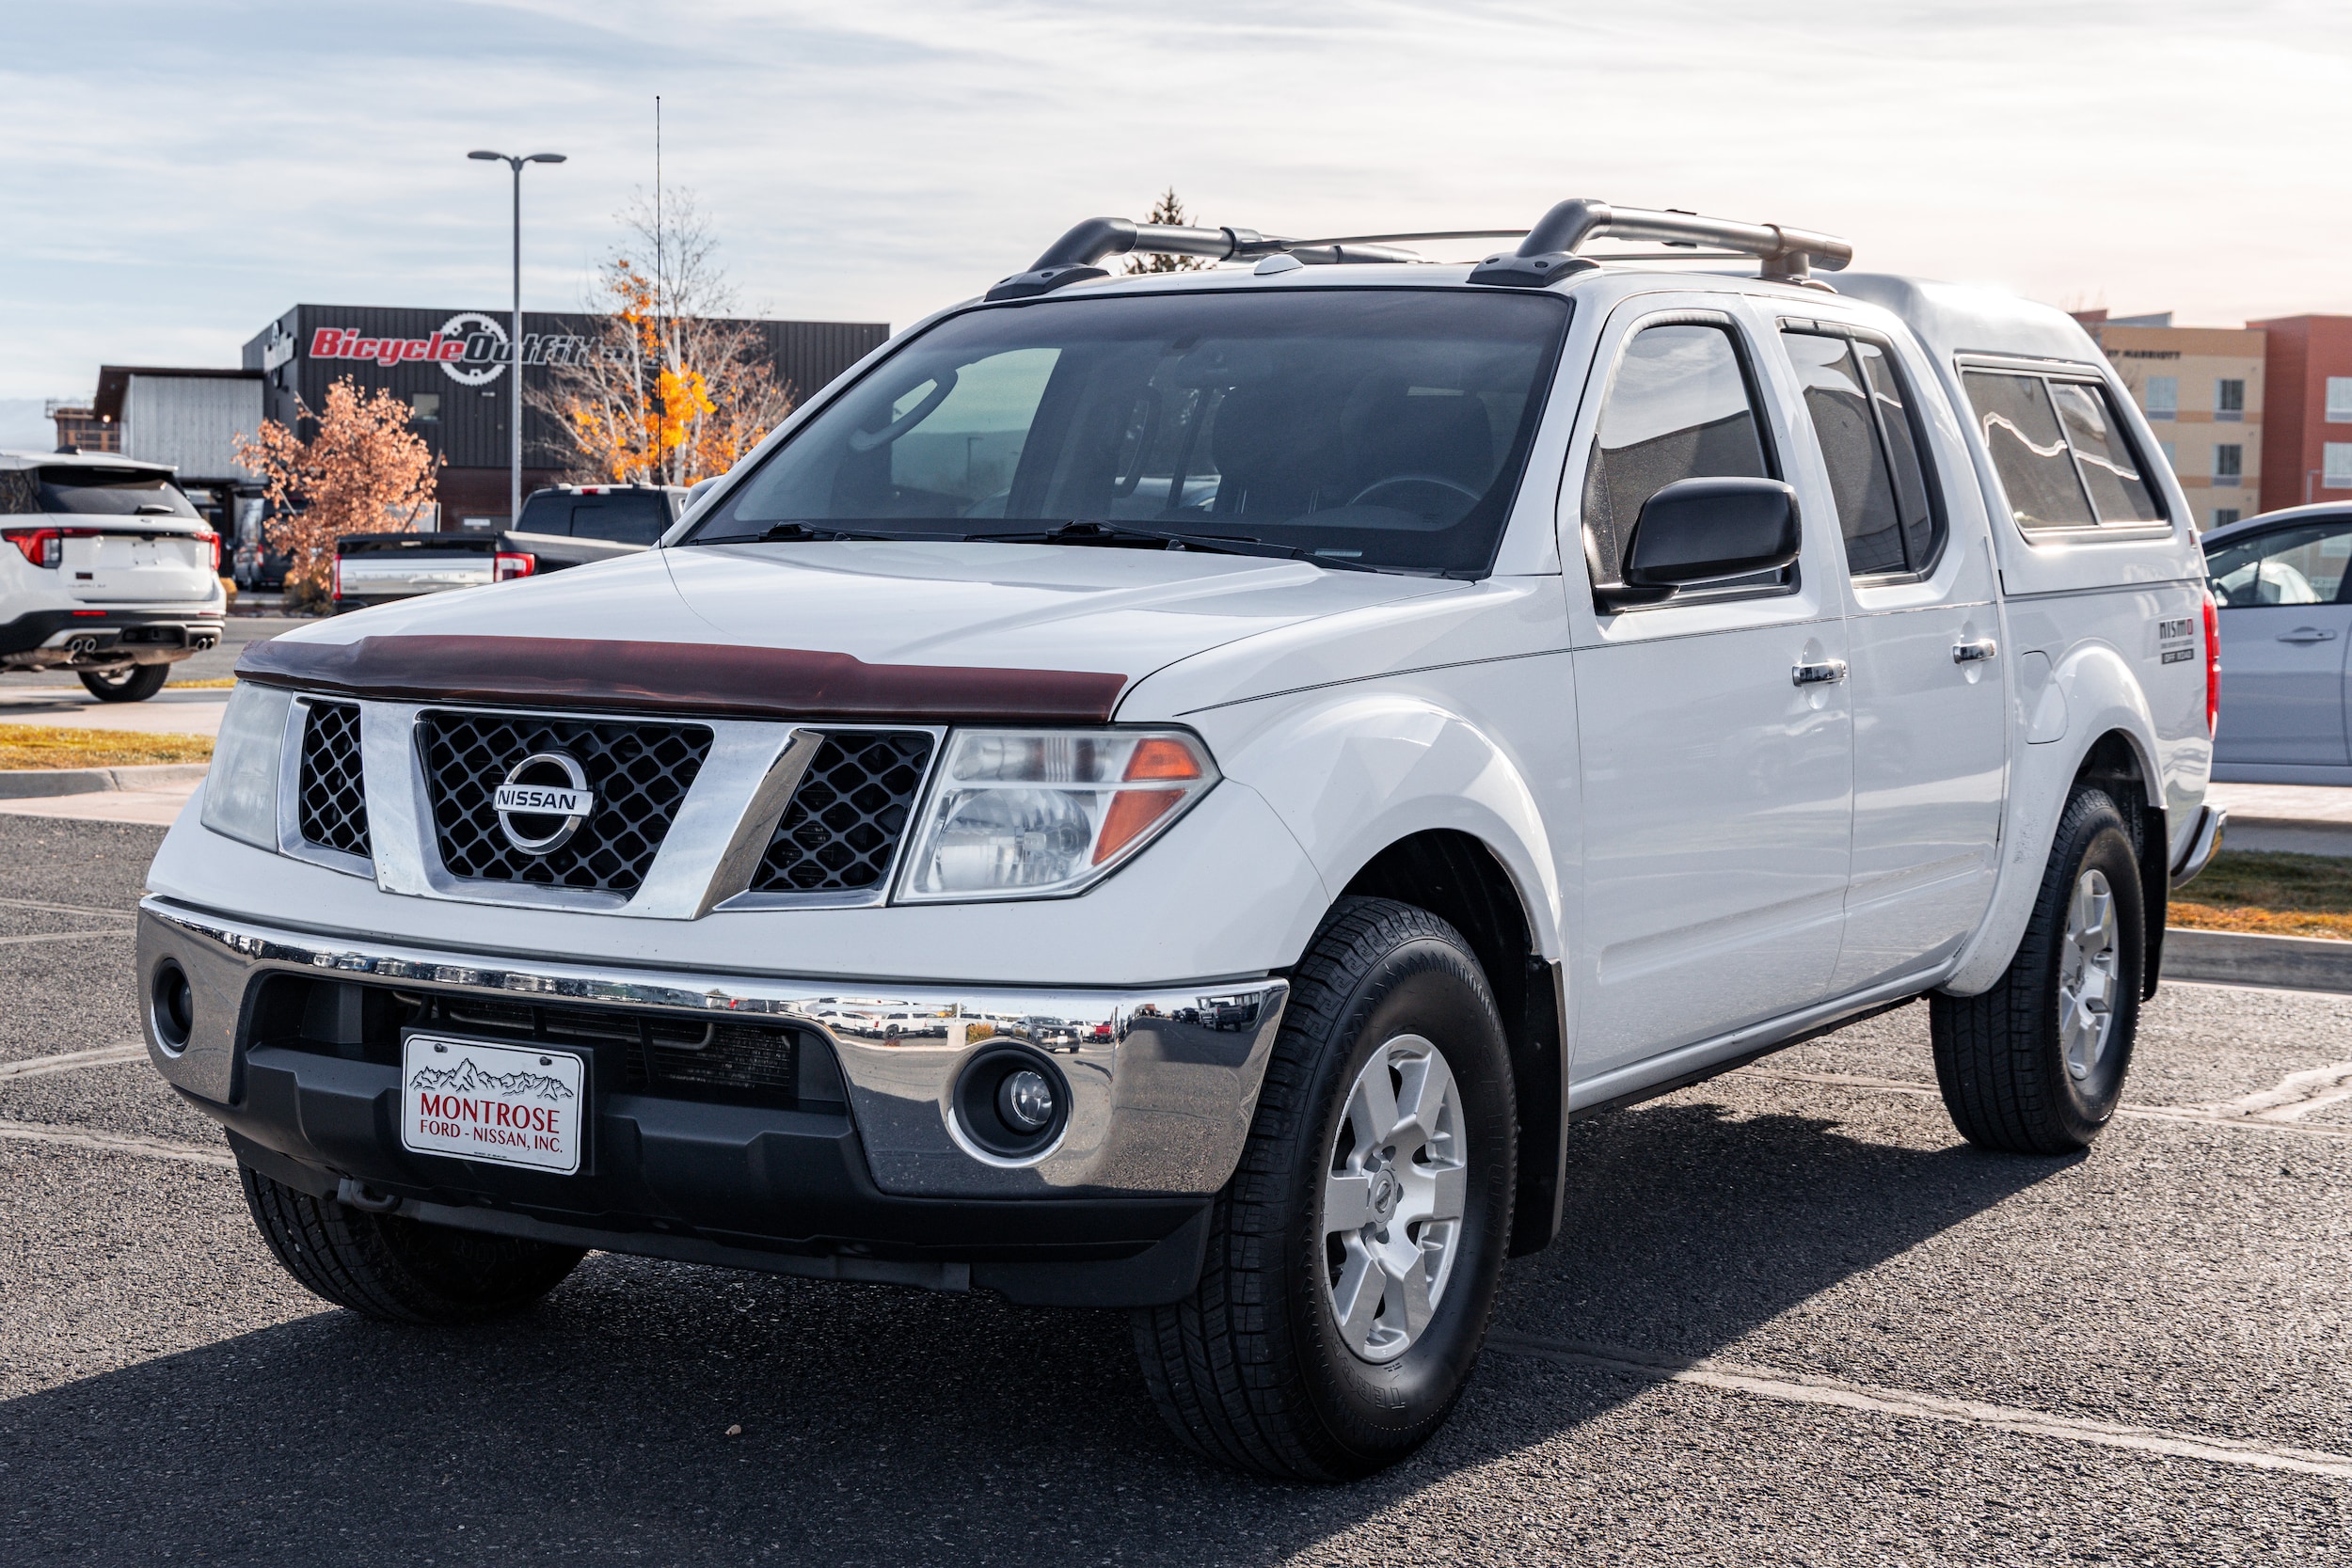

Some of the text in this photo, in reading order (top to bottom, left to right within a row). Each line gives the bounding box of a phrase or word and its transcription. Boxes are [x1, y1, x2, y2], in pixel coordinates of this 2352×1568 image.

[310, 327, 465, 367] Bicycle
[2122, 350, 2181, 359] MARRIOTT
[498, 789, 577, 810] NISSAN
[421, 1092, 561, 1133] MONTROSE
[421, 1119, 461, 1138] FORD
[473, 1127, 531, 1151] NISSAN,
[534, 1134, 563, 1153] INC.
